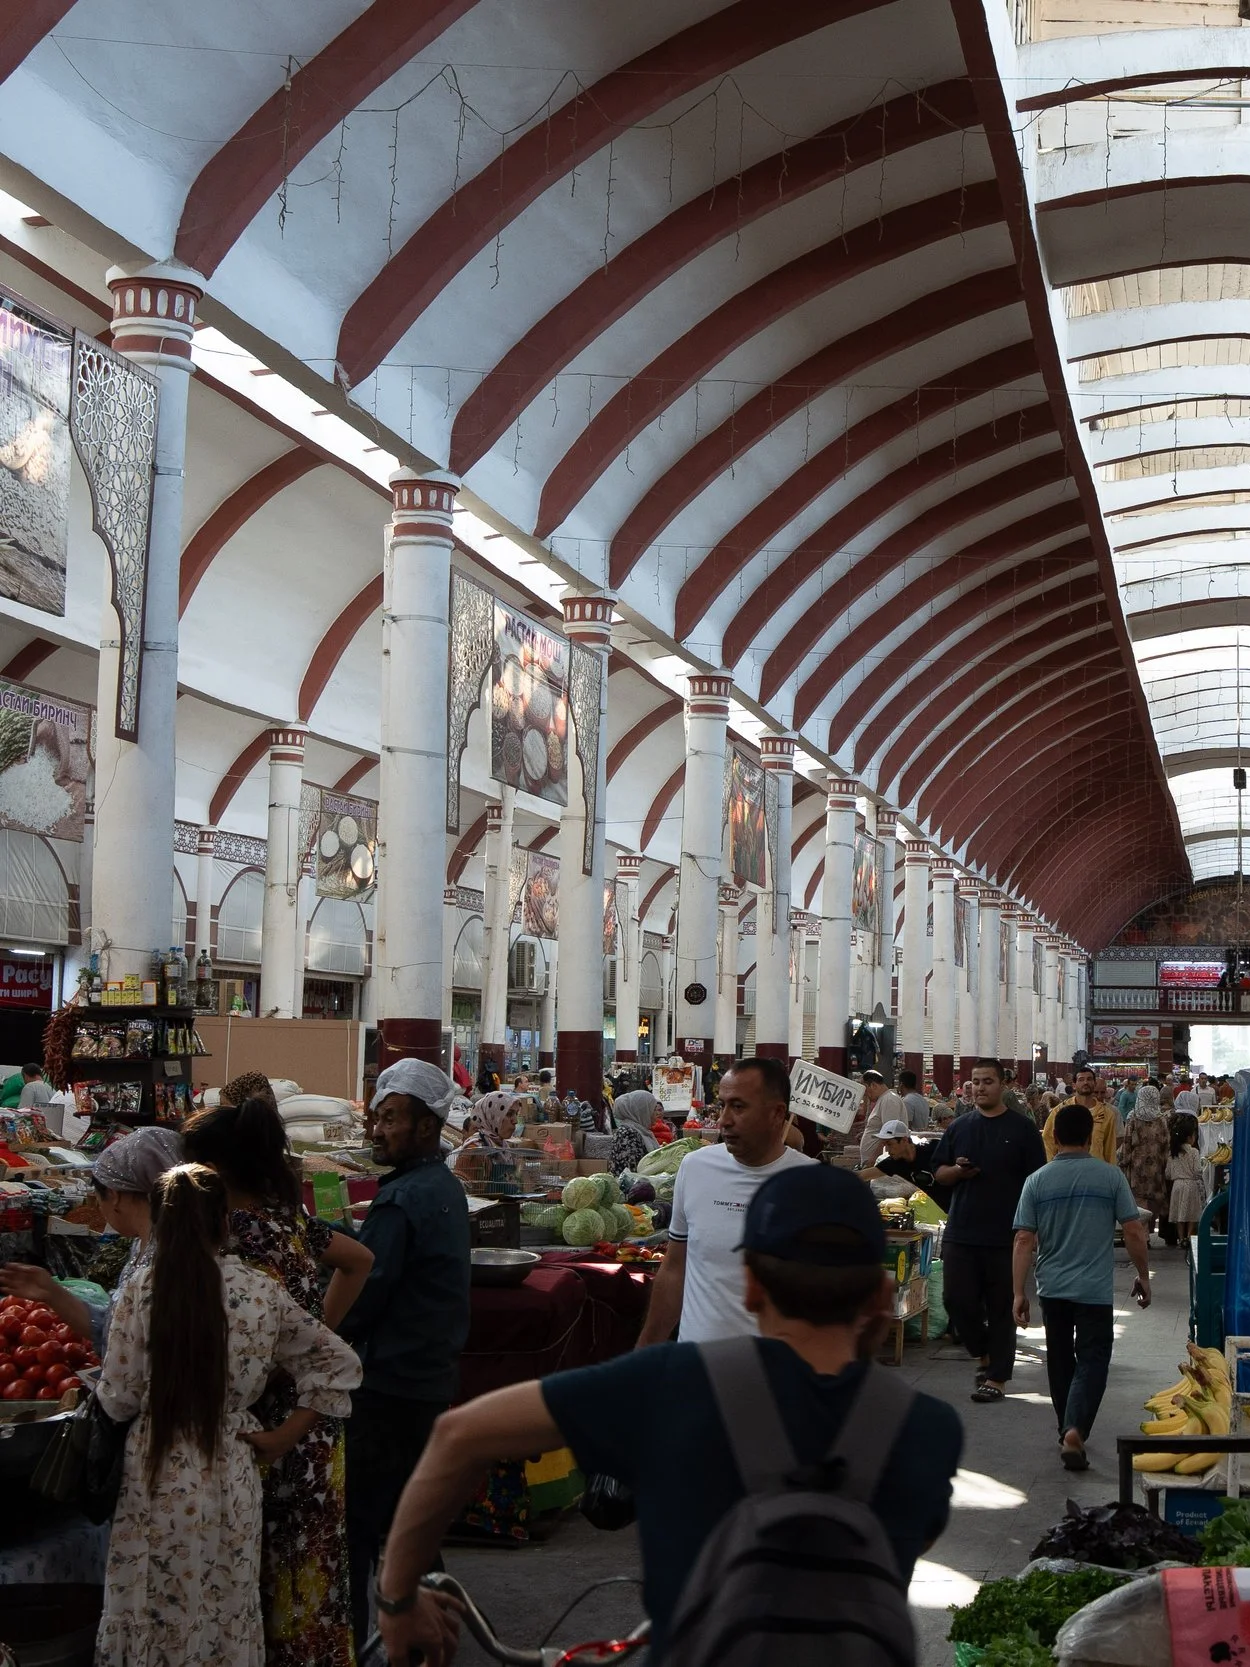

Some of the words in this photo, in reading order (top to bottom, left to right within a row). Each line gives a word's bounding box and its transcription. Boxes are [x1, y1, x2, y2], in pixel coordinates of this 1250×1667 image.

[540, 633, 562, 663] МОШ
[0, 690, 30, 713] СТАИ
[794, 1069, 853, 1108] ИМБИР
[1176, 1511, 1207, 1519] Product
[1202, 1568, 1216, 1612] ПАКЕТЫ
